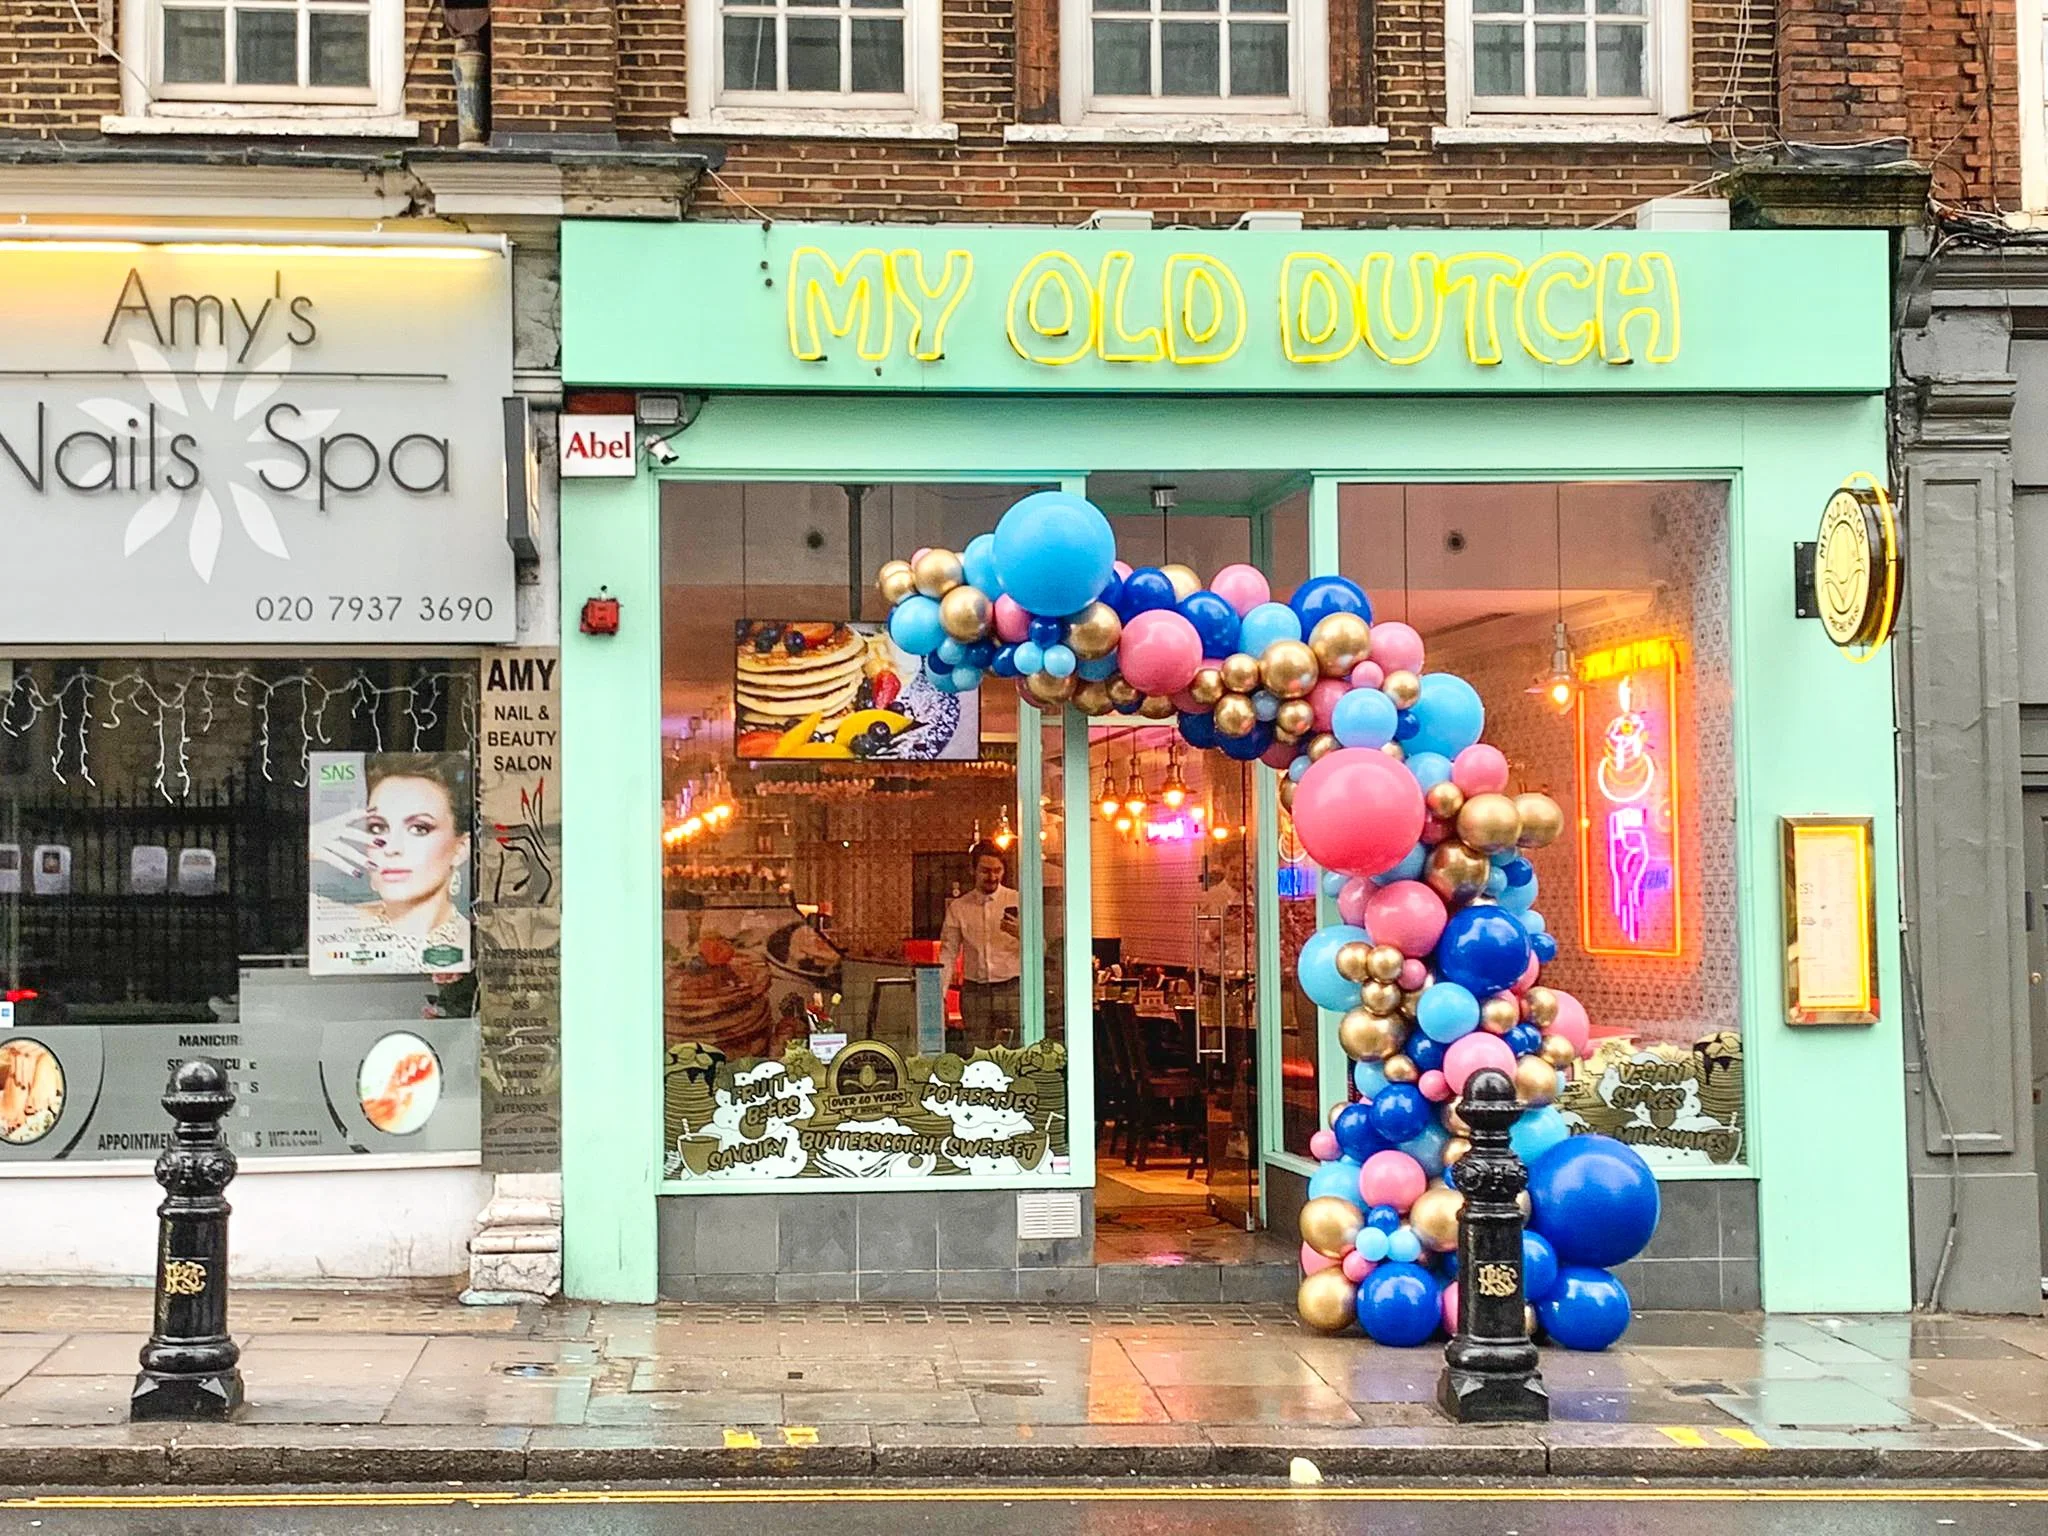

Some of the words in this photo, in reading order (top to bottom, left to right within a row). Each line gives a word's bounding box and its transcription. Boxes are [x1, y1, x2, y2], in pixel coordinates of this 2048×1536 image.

[102, 267, 317, 364] Amy's
[787, 247, 974, 361] MY
[1006, 250, 1247, 365] OLD
[1280, 251, 1682, 367] DUTCH
[258, 402, 450, 512] Spa
[565, 431, 632, 459] Abel
[255, 597, 314, 622] 020
[329, 597, 402, 622] 7937
[419, 597, 493, 622] 3690
[487, 658, 557, 692] AMY
[494, 705, 533, 721] NAIL
[538, 705, 550, 721] &
[487, 731, 557, 747] BEAUTY
[320, 764, 356, 781] SNS
[493, 755, 552, 772] SALON
[178, 1034, 242, 1047] MANICUR
[729, 1071, 788, 1106] FRUIT
[831, 1096, 857, 1107] OVER
[859, 1095, 872, 1105] 60
[872, 1092, 904, 1103] YEARS
[921, 1081, 1040, 1115] POFFERTJES
[745, 1094, 801, 1126] BEERS
[707, 1137, 788, 1171] SAVOURY
[799, 1130, 937, 1155] BUTTERSCOTCH
[945, 1136, 1037, 1160] SWEEEET
